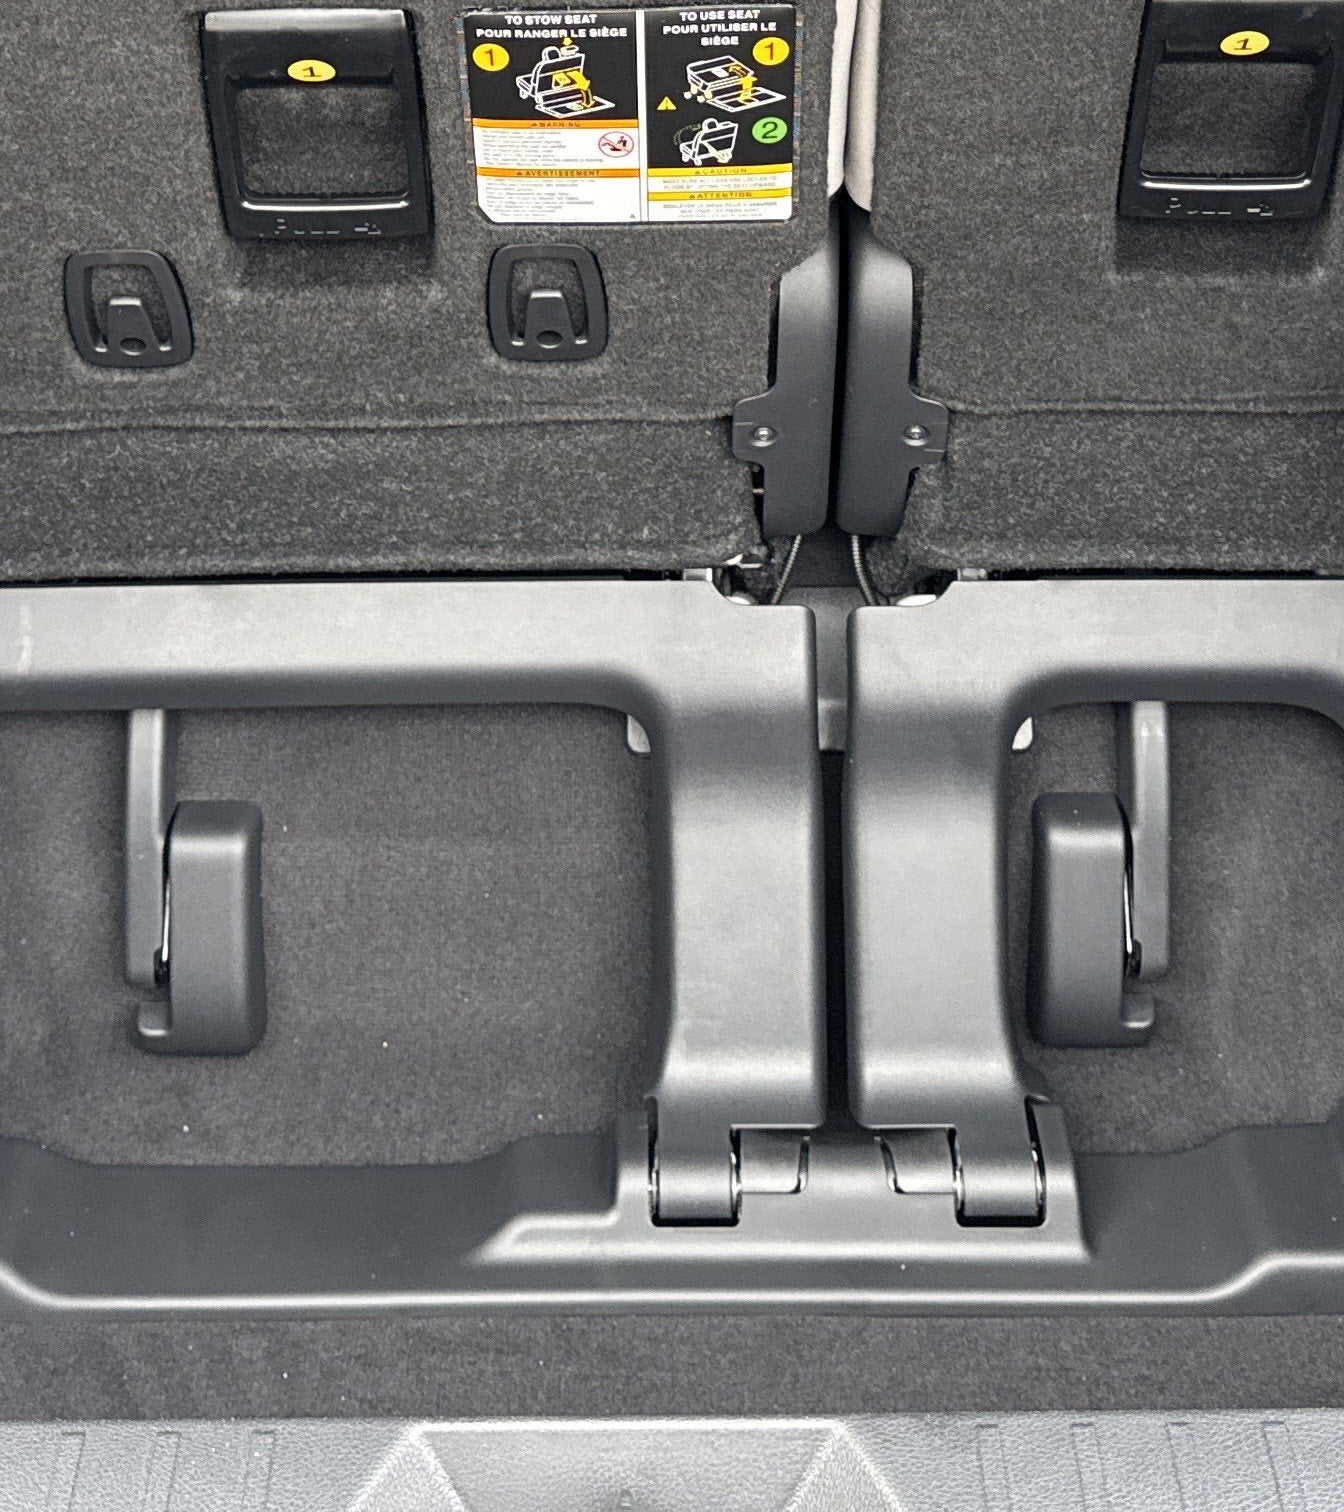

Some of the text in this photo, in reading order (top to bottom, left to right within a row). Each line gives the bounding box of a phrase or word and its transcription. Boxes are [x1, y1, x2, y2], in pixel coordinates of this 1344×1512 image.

[504, 14, 598, 25] TO STOW SEAT
[679, 9, 761, 22] TO USE SEAT
[475, 25, 628, 38] POUR RANGER LE SIÈGE
[662, 21, 777, 35] POUR UTILISER LE
[700, 35, 740, 46] SIÈGE
[1233, 37, 1253, 50] 1
[484, 48, 495, 67] 1
[764, 41, 774, 61] 1
[302, 65, 322, 78] 1
[761, 121, 778, 139] 2
